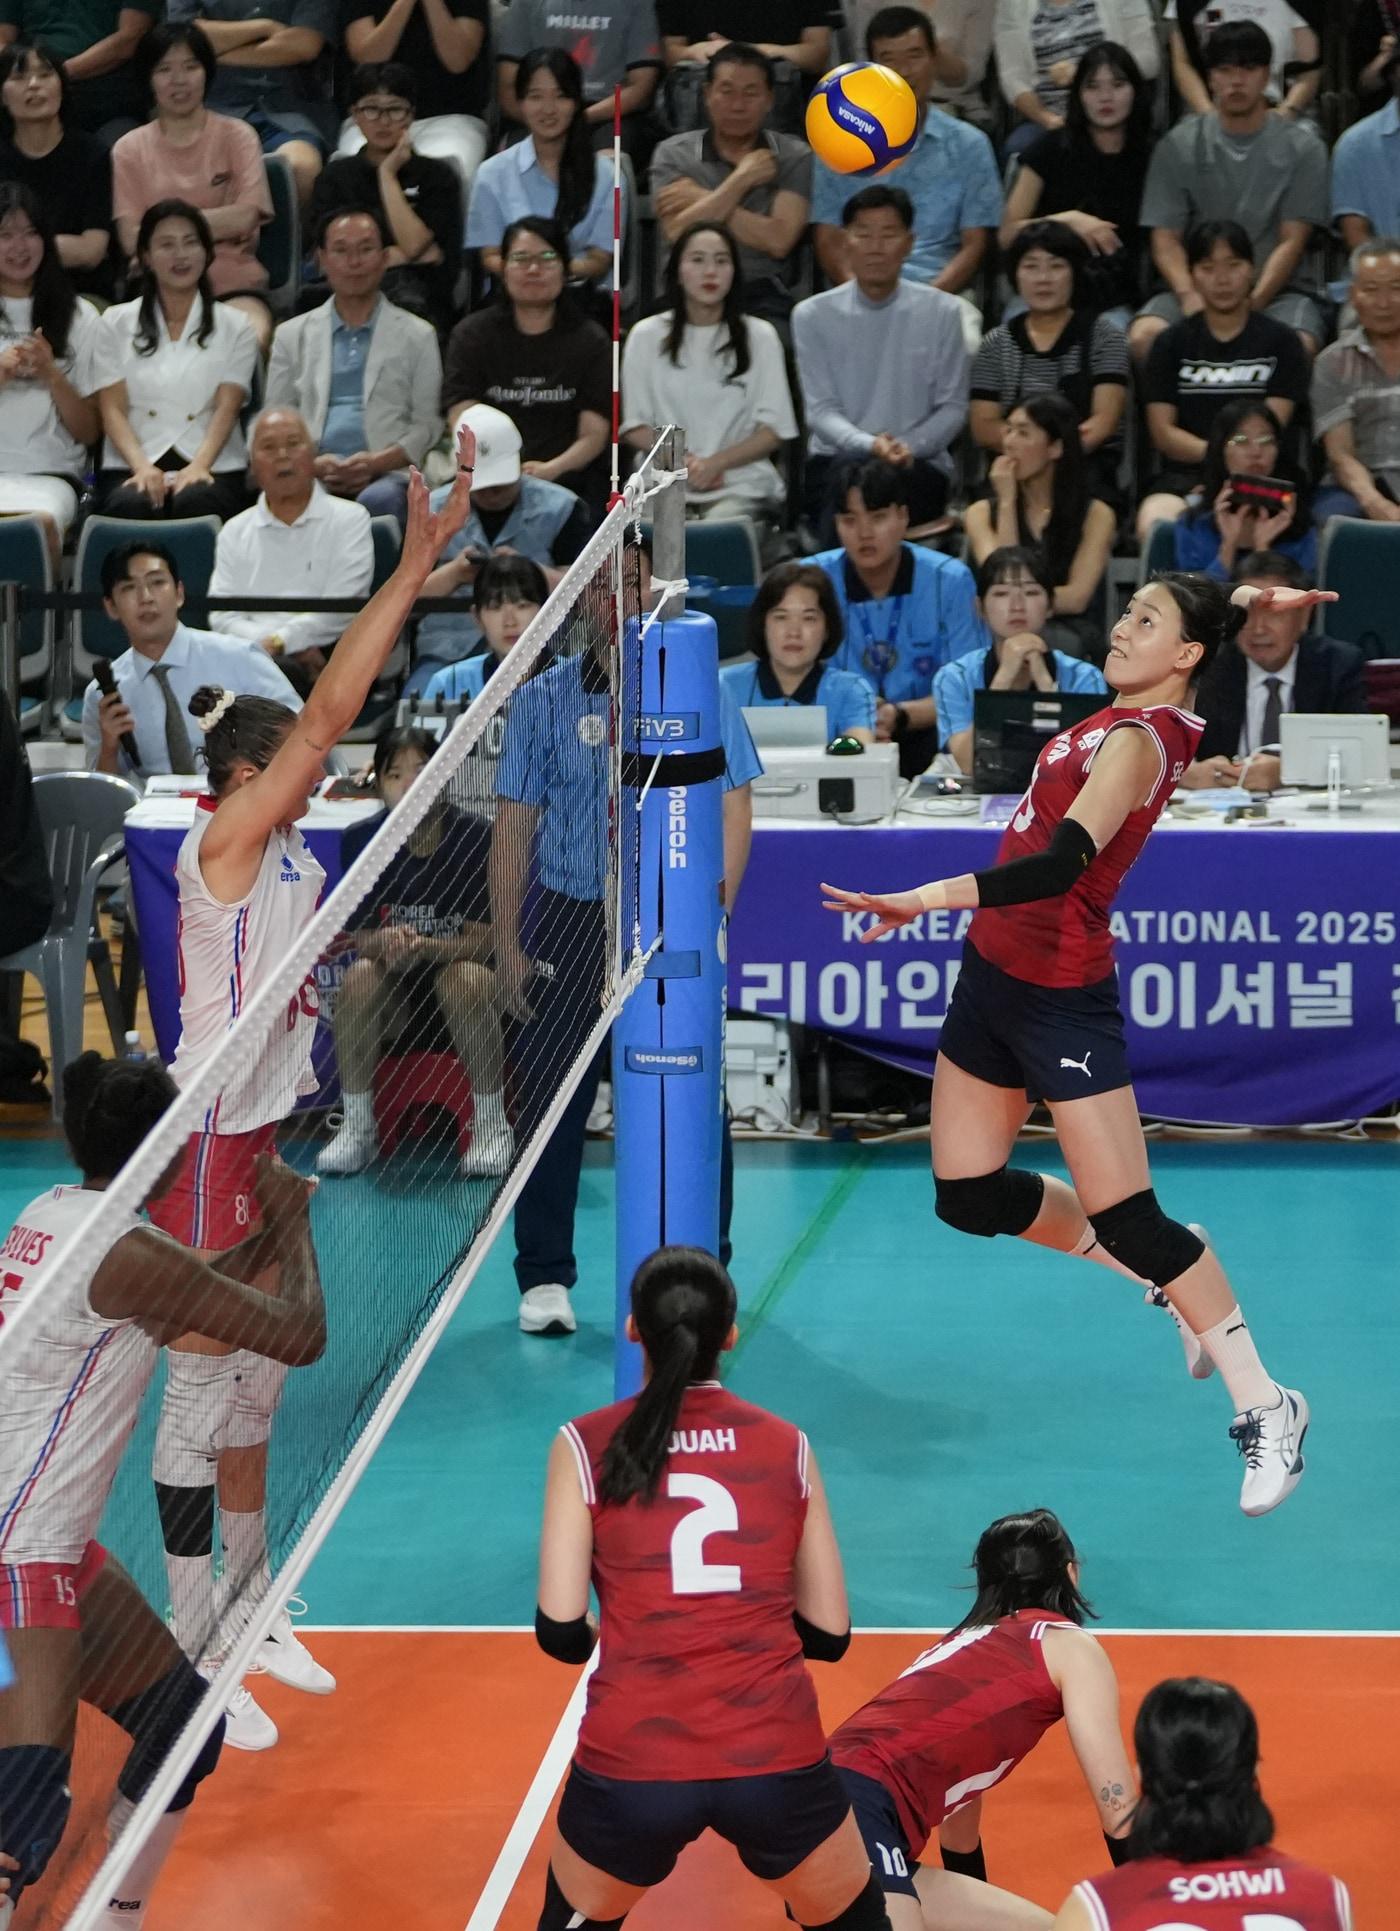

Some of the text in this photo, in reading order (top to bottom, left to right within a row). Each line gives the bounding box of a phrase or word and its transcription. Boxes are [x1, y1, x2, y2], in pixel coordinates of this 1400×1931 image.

[546, 14, 612, 30] MILLET
[1296, 911, 1396, 944] 2025
[668, 1473, 742, 1594] 2
[52, 1574, 76, 1606] 15
[876, 1841, 909, 1877] 10
[1168, 1868, 1286, 1903] SOHWI
